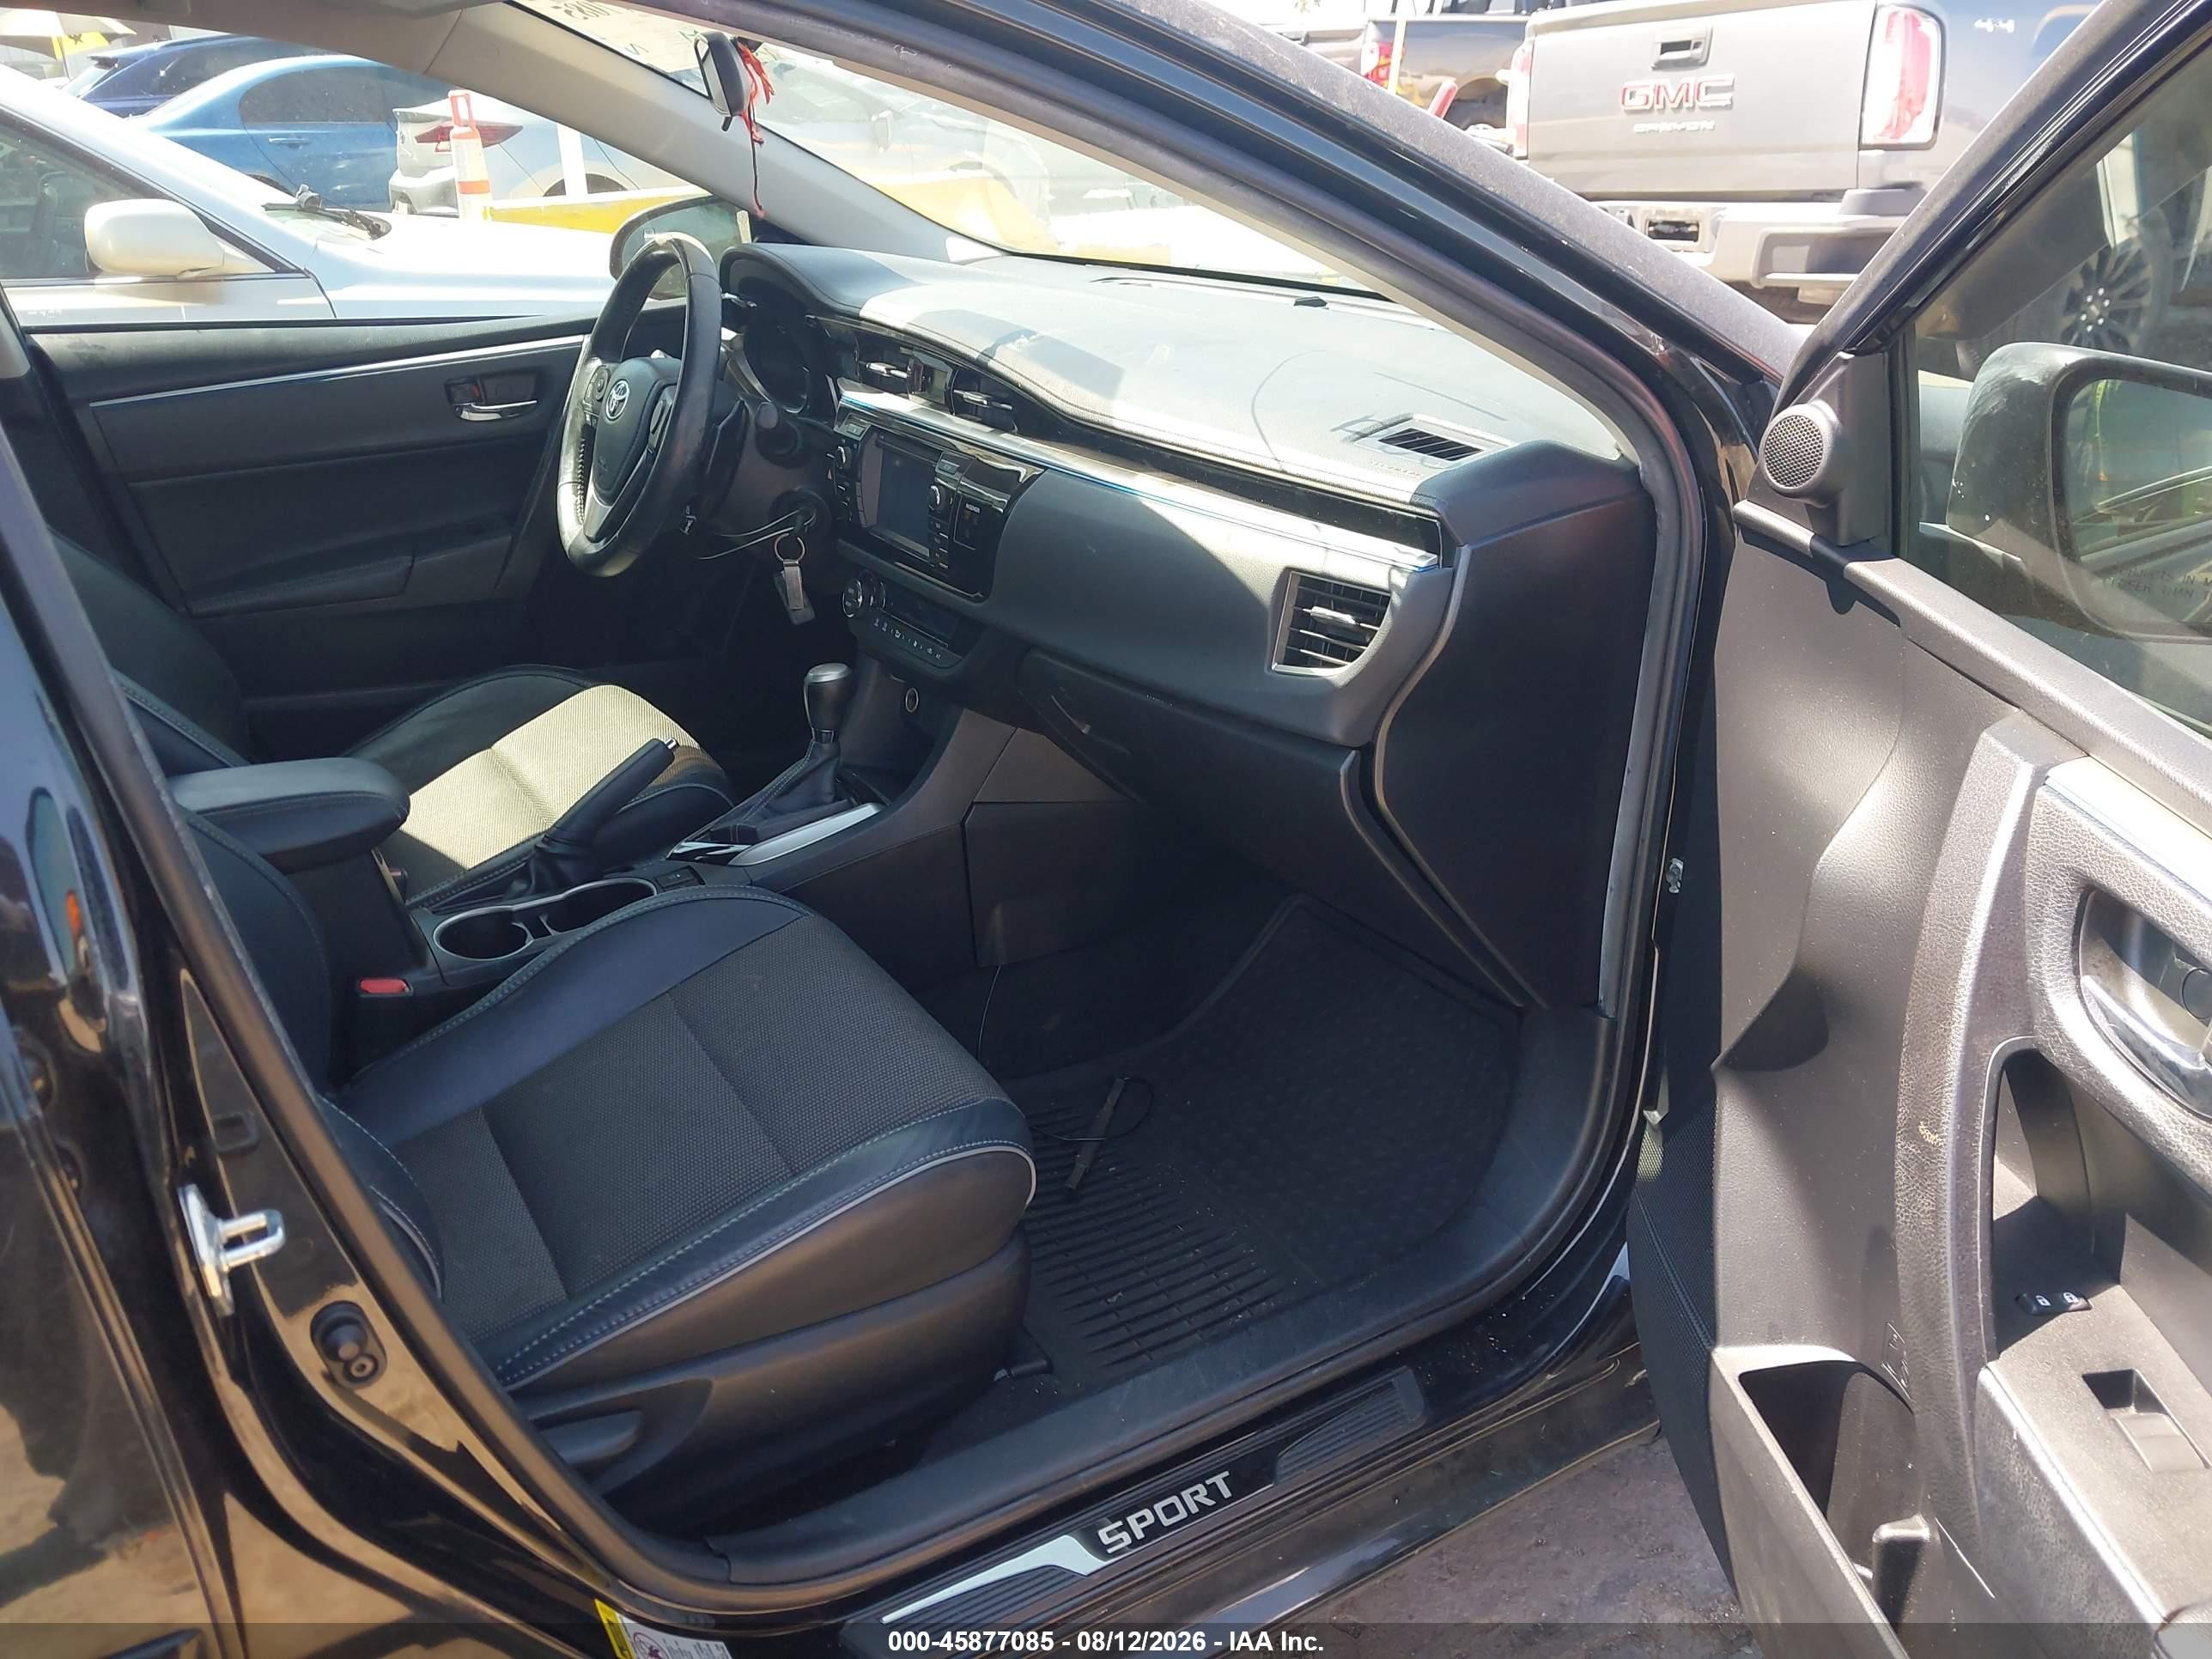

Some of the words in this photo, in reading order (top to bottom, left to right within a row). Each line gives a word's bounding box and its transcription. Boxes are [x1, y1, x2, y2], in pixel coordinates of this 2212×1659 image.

[1621, 74, 1735, 112] GMC
[1633, 119, 1716, 133] CANYON
[1097, 1470, 1233, 1554] SPORT
